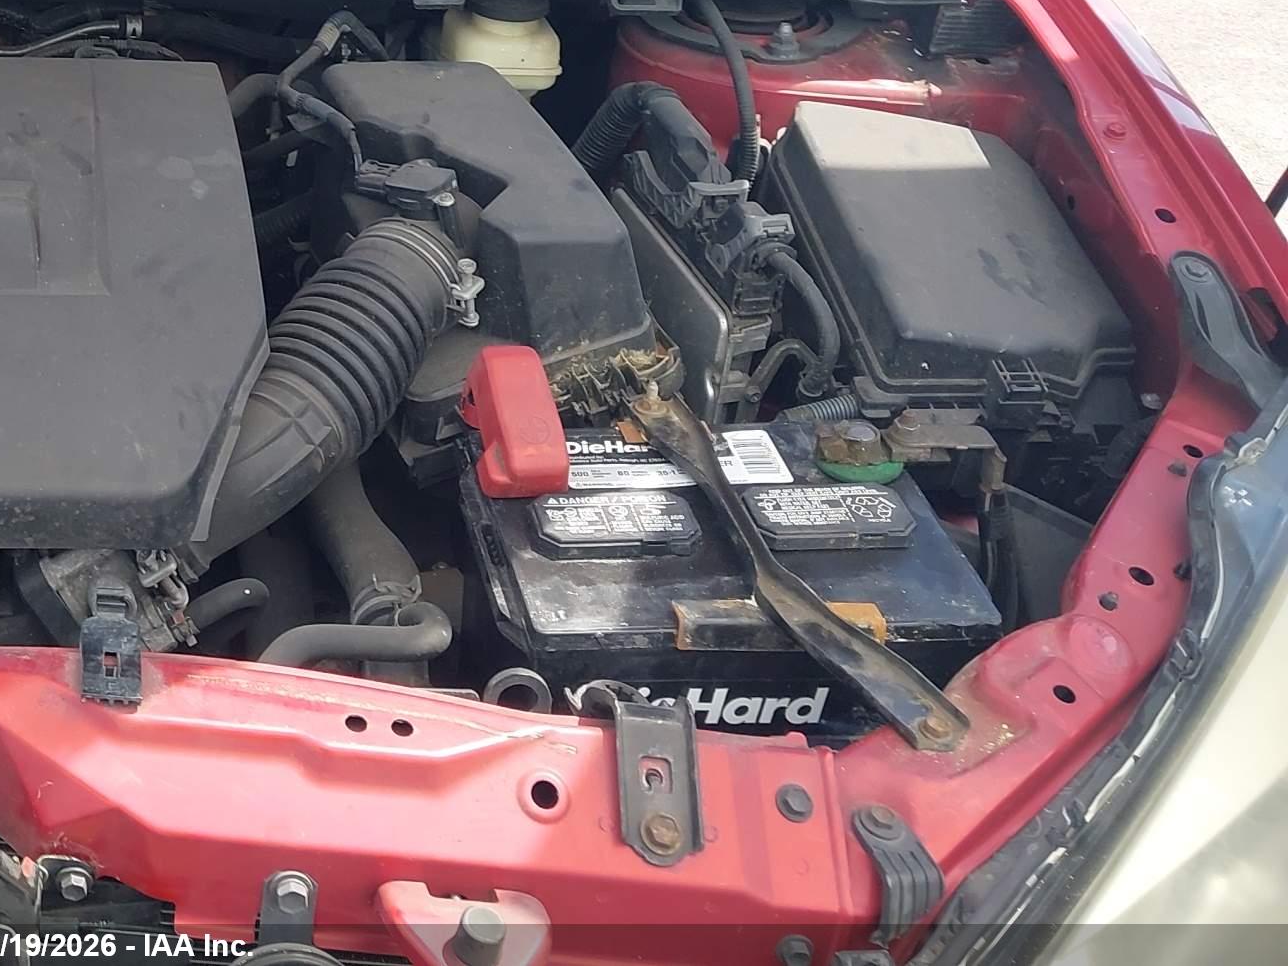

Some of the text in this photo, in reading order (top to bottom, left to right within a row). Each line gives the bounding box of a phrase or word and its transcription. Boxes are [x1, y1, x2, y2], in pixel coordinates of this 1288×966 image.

[566, 440, 654, 454] DieHar
[559, 496, 610, 505] DANGER
[622, 494, 667, 504] POISON
